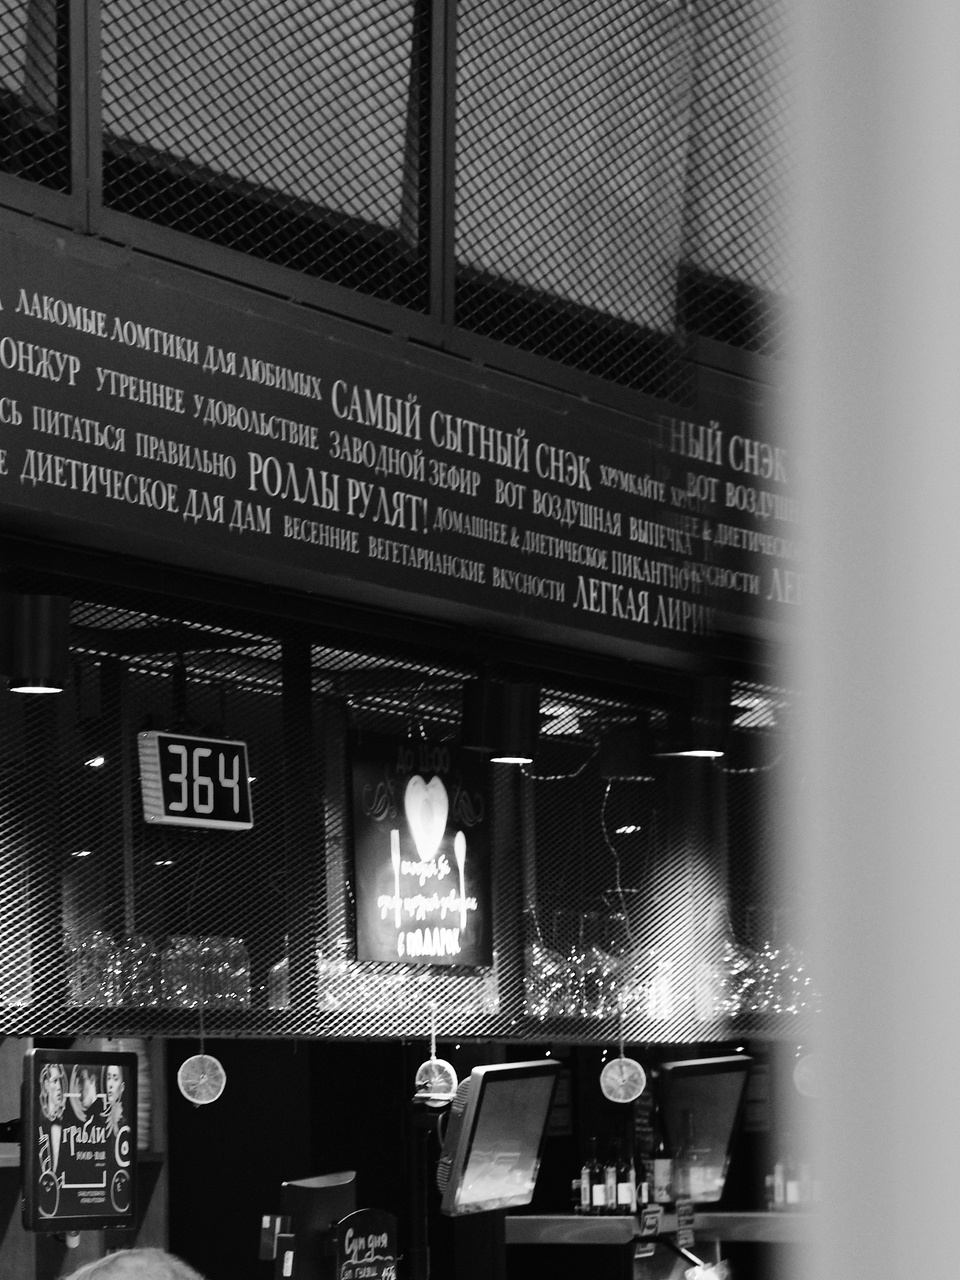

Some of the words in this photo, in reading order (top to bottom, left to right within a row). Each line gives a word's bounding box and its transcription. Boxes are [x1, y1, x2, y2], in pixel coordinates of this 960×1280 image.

[15, 288, 108, 338] ЛАКОМЫЕ
[110, 317, 199, 365] ЛОМТИКИ
[202, 345, 237, 376] ДЛЯ
[239, 356, 323, 401] ЛЮБИМЫХ
[331, 379, 423, 442] САМЫЙ
[430, 410, 530, 474] СЫТНЫЙ
[535, 443, 592, 492] СНЭК
[599, 464, 666, 503] ХРУМКАЙТЕ
[96, 366, 185, 414] УТРЕННЕЕ
[193, 393, 320, 451] УДОВОЛЬСТВИЕ
[328, 430, 425, 483] ЗАВОДНОЙ
[428, 458, 481, 497] ЗЕФИР
[495, 478, 527, 511] ВОТ
[532, 488, 622, 538] ВОЗДУШНАЯ
[629, 516, 693, 556] ВЫПЕЧКА
[20, 449, 179, 515] ДИЕТИЧЕСКОЕ
[183, 488, 225, 525] ДЛЯ
[229, 499, 272, 535] ДАМ
[283, 515, 360, 554] ВЕСЕННИЕ
[368, 535, 486, 585] ВЕГЕТАРИАНСКИЕ
[492, 566, 566, 603] ВКУСНОСТИ
[572, 575, 650, 625] ЛЕГКАЯ
[32, 405, 125, 452] ПИТАТЬСЯ
[136, 432, 236, 480] ПРАВИЛЬНО
[248, 451, 340, 512] РОЛЛЫ
[347, 477, 428, 534] РУЛЯТ!
[433, 506, 508, 546] ДОМАШНЕЕ
[522, 530, 609, 571] ДИЕТИЧЕСКОЕ
[168, 744, 240, 815] 364
